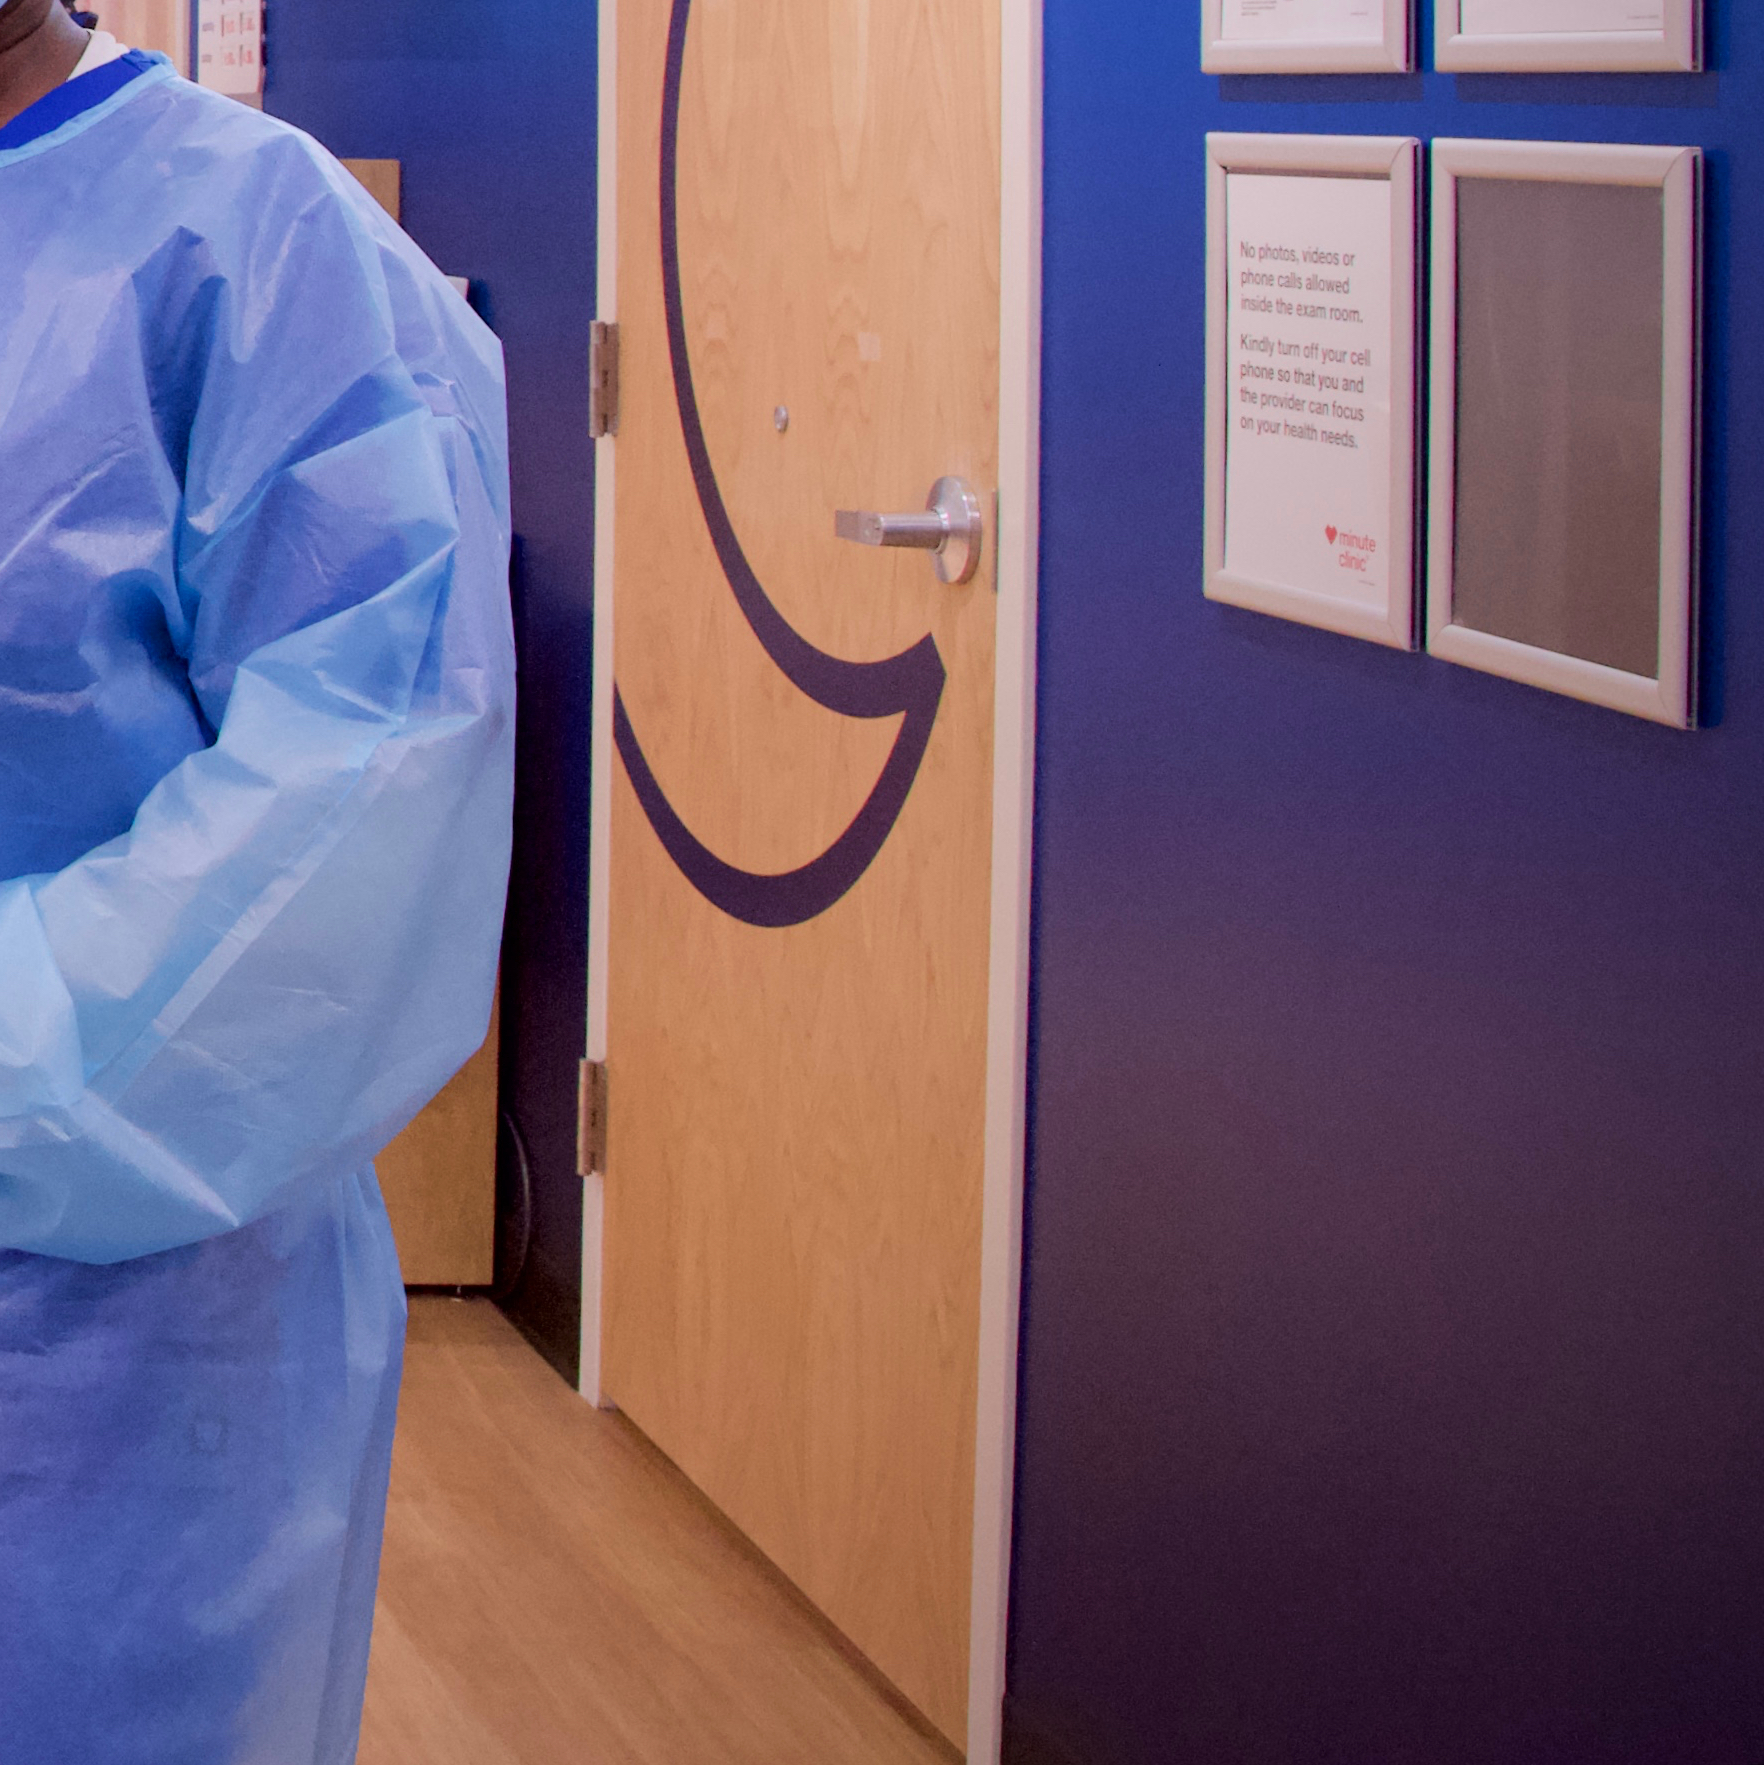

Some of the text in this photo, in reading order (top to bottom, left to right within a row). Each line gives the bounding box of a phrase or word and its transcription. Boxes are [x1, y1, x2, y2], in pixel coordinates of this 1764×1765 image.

[1240, 241, 1355, 266] No photos, videos or
[1241, 268, 1350, 294] phone calls allowed
[1241, 294, 1363, 323] inside the exam room.
[1240, 333, 1371, 366] Kindly turn off your cell
[1240, 361, 1364, 393] phone so that you and
[1240, 386, 1364, 421] the provider can focus
[1240, 416, 1358, 449] on your health needs.
[1339, 529, 1376, 553] minute
[1339, 551, 1367, 572] clinic
